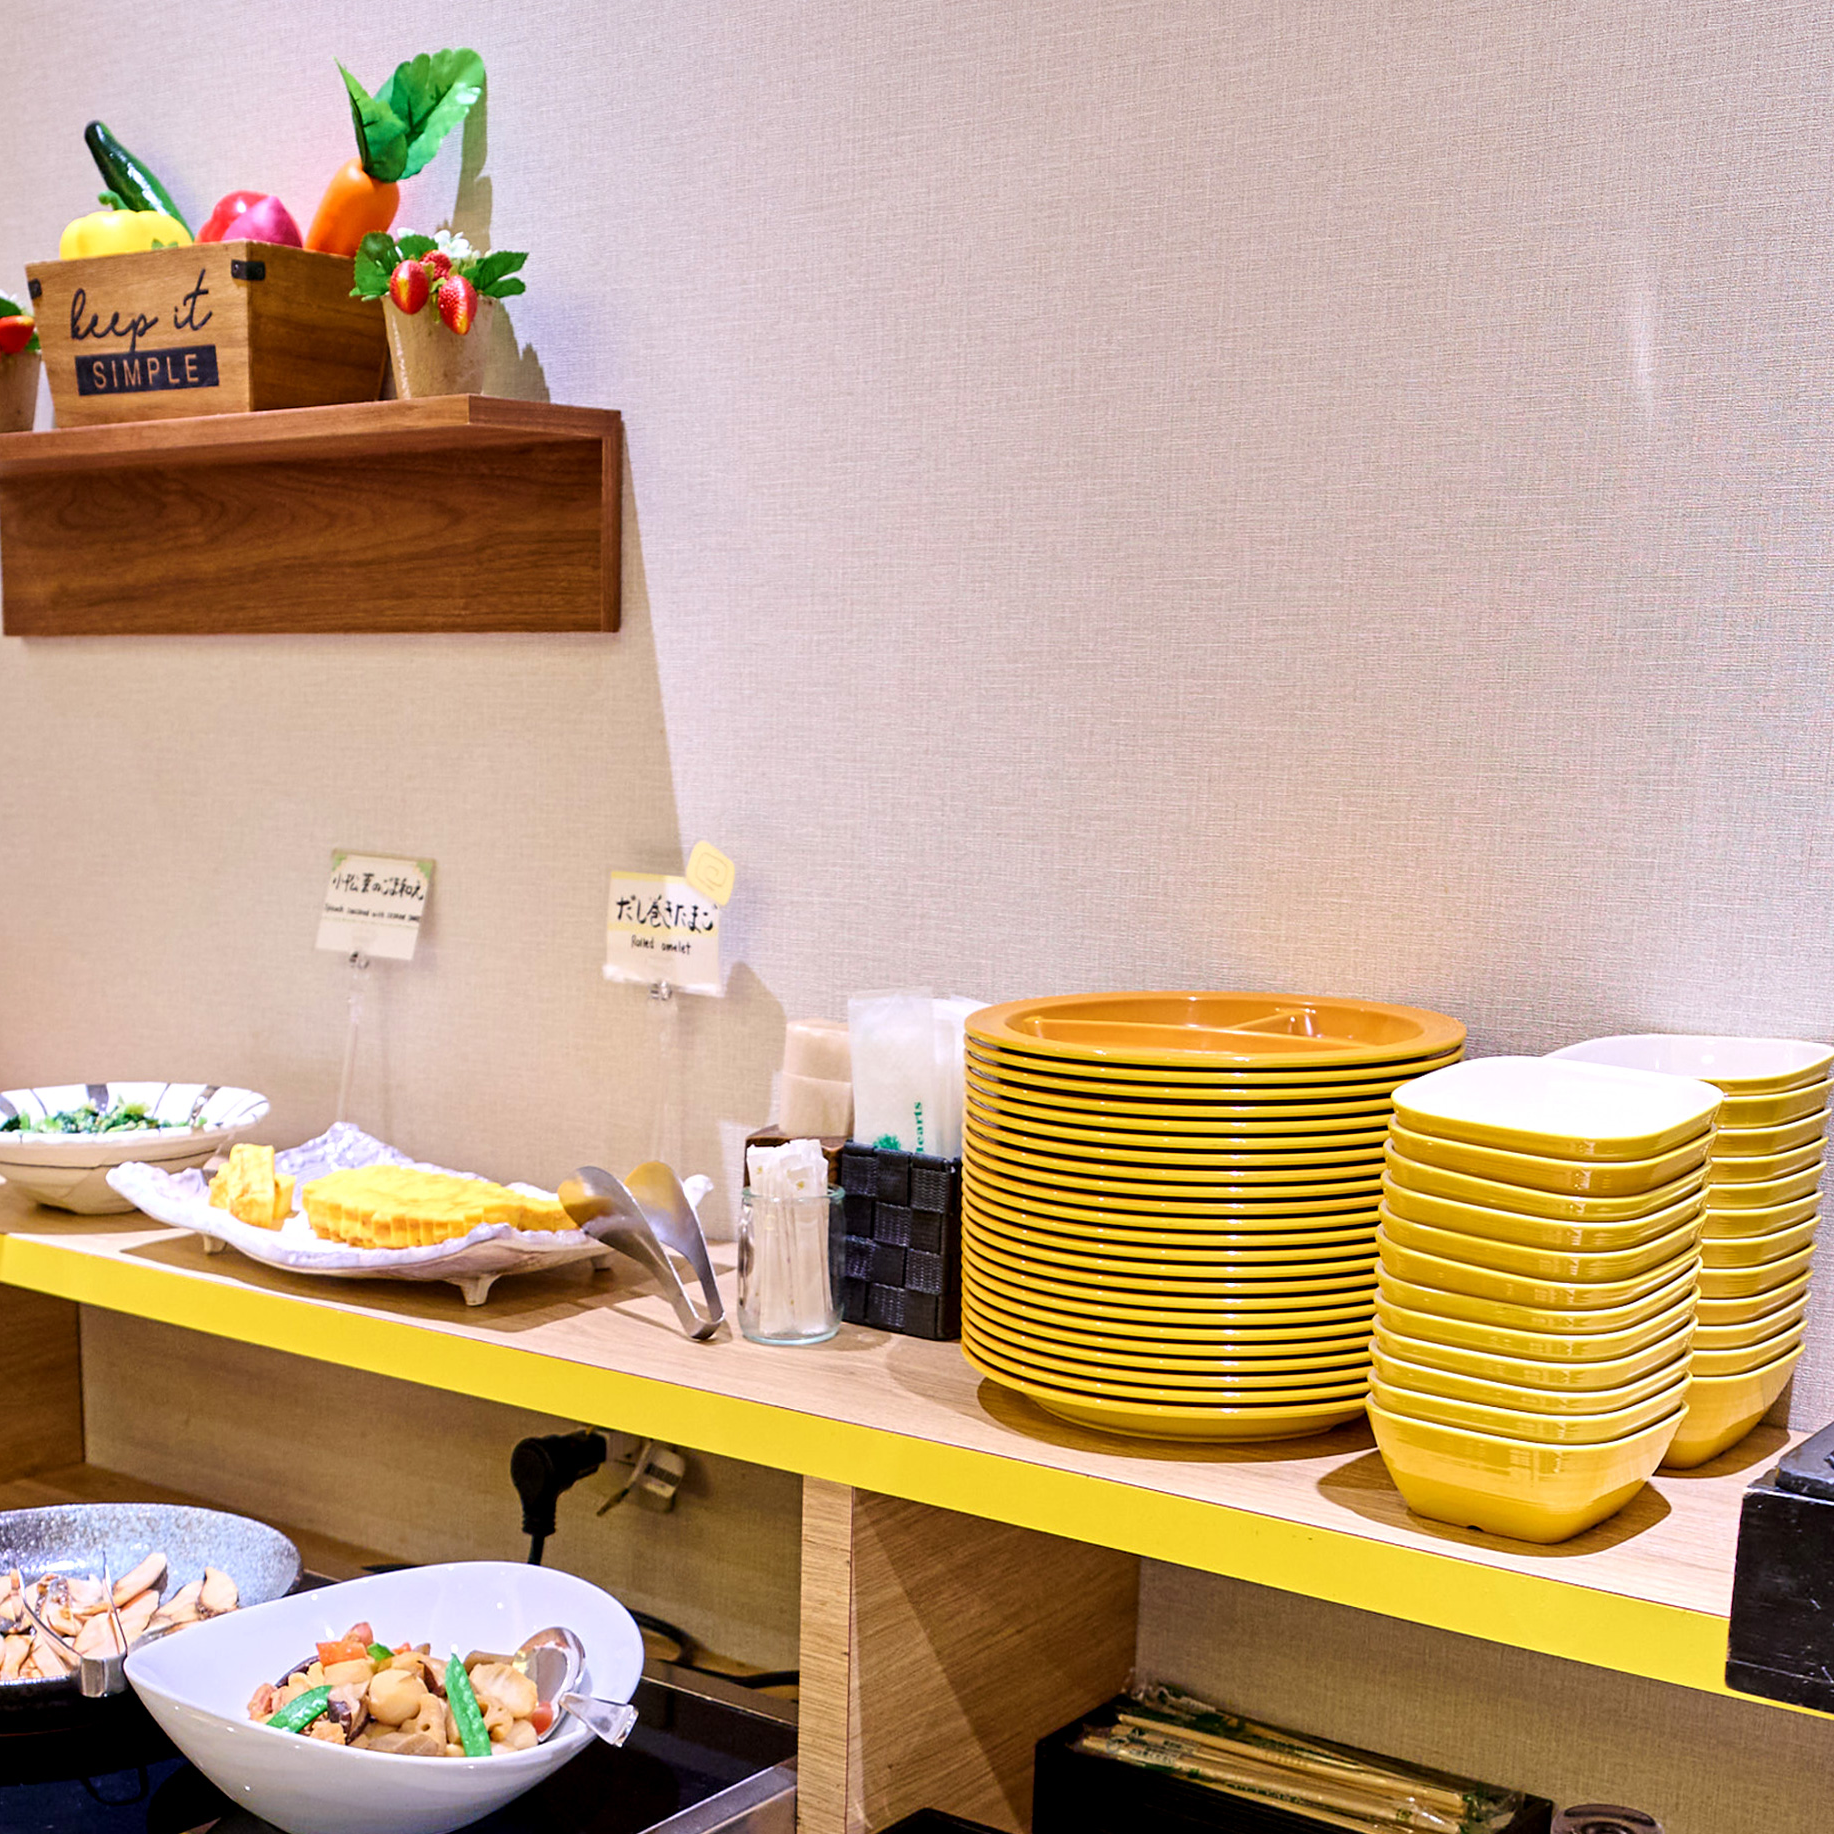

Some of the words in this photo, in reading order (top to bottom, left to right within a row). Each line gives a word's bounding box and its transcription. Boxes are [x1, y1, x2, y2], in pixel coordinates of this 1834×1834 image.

[71, 288, 159, 353] keep
[174, 268, 213, 331] it
[92, 353, 200, 390] SIMPLE
